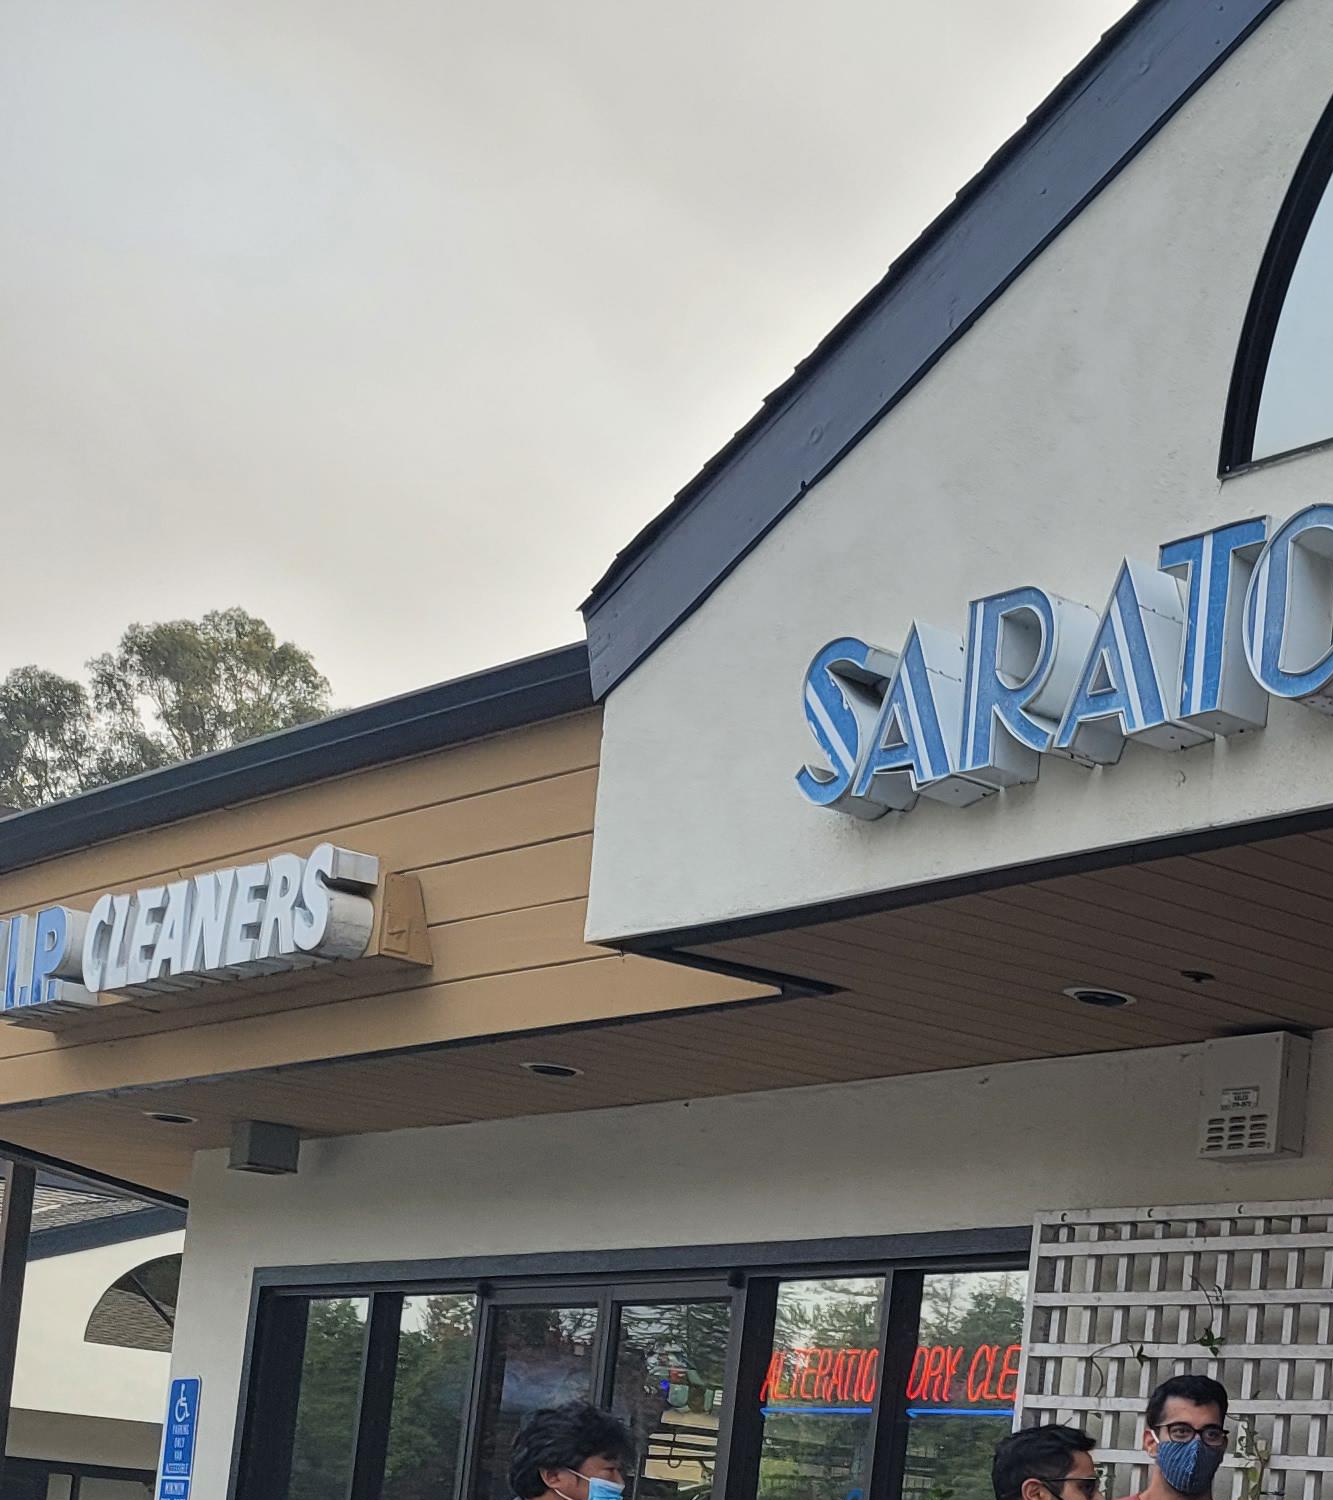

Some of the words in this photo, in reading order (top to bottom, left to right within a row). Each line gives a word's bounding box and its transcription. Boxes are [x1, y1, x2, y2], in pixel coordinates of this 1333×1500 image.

[0, 904, 68, 1010] I.P.
[82, 842, 337, 993] CLEANERS
[905, 1344, 965, 1402] DRY
[966, 1344, 1023, 1402] CLE
